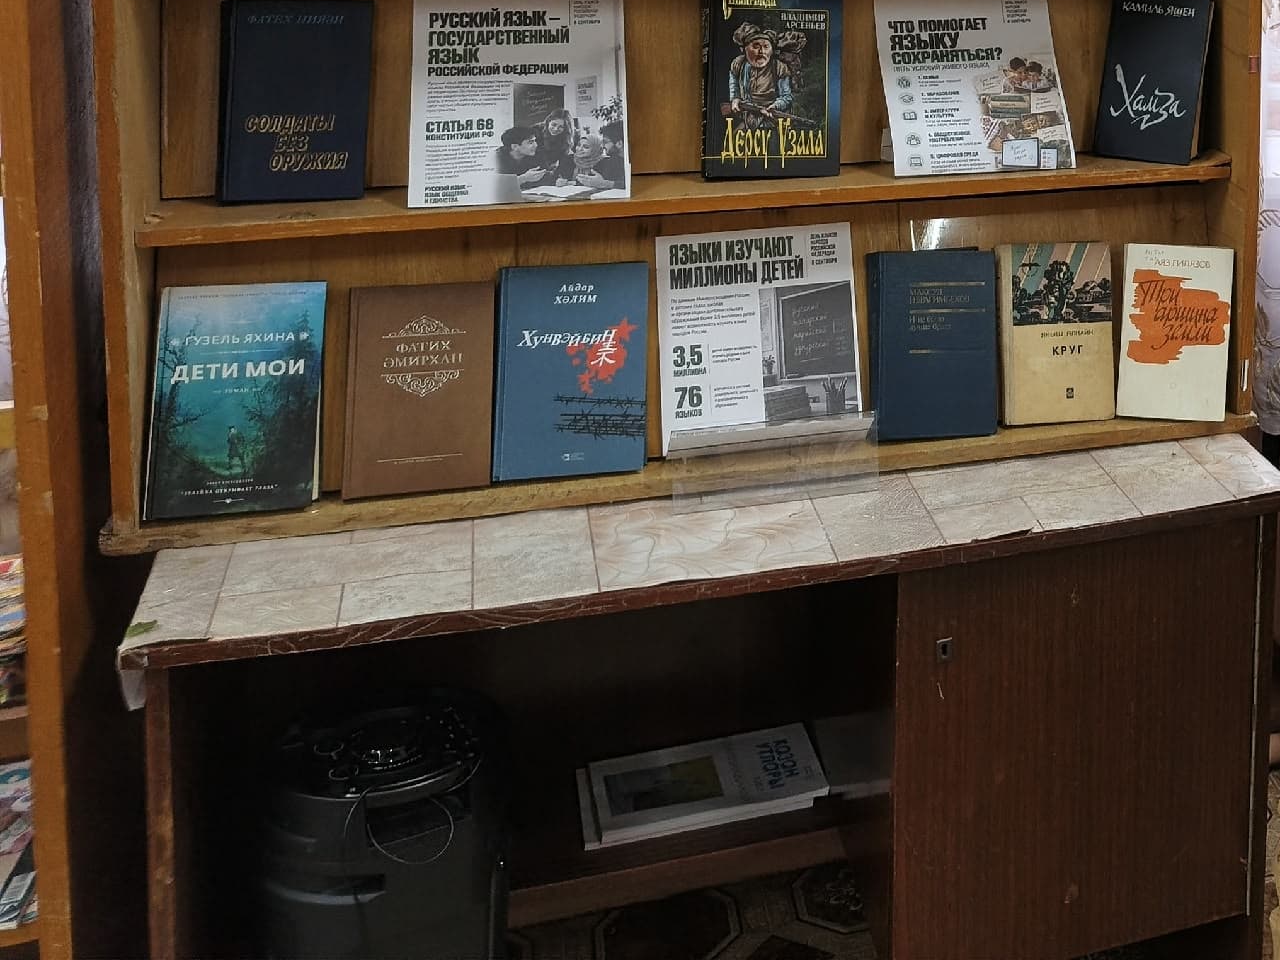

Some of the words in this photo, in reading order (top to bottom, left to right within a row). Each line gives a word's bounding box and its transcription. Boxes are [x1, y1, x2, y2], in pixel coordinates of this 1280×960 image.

[1122, 1, 1164, 14] КАМИЛЬ
[1164, 5, 1195, 17] ЯШЕН
[429, 8, 500, 29] РУССКИЙ
[502, 11, 547, 27] ЯЗЫК
[785, 21, 826, 30] АРСЕНЬЕВ
[888, 20, 915, 34] ЧТО
[918, 18, 987, 33] ПОМОГАЕТ
[428, 25, 570, 48] ГОСУДАРСТВЕННЫЙ
[890, 31, 960, 51] ЯЗЫКУ
[428, 47, 480, 65] ЯЗЫК
[892, 46, 1002, 65] СОХРАНЯТЬСЯ?
[427, 63, 500, 77] РОССИЙСКОЙ
[503, 63, 569, 76] ФЕДЕРАЦИИ
[1110, 64, 1186, 130] Хамза
[245, 112, 335, 134] СОЛДАТЫ
[426, 119, 473, 133] СТАТЬЯ
[476, 118, 494, 130] 68
[275, 134, 309, 152] БЕЗ
[425, 132, 480, 141] КОНСТИТУЦИИ
[482, 131, 494, 139] РФ
[721, 117, 772, 169] Дерсу
[778, 117, 824, 169] Узала
[269, 151, 348, 172] ОРУЖИЯ
[669, 241, 722, 266] ЯЗЫКИ
[725, 235, 794, 260] ИЗУЧАЮТ
[670, 263, 758, 290] МИЛЛИОНЫ
[761, 255, 804, 284] ДЕТЕЙ
[185, 335, 240, 346] ГУЗЕЛЬ
[244, 331, 295, 344] ЯХИНА
[396, 340, 451, 353] ФАТИХ
[672, 344, 703, 368] 3,5
[1052, 345, 1083, 356] КРУГ
[170, 362, 238, 384] ДЕТИ
[245, 359, 306, 378] МОИ
[673, 368, 707, 377] МИЛЛИОНА
[674, 385, 703, 409] 76
[675, 408, 703, 419] ЯЗЫКОВ
